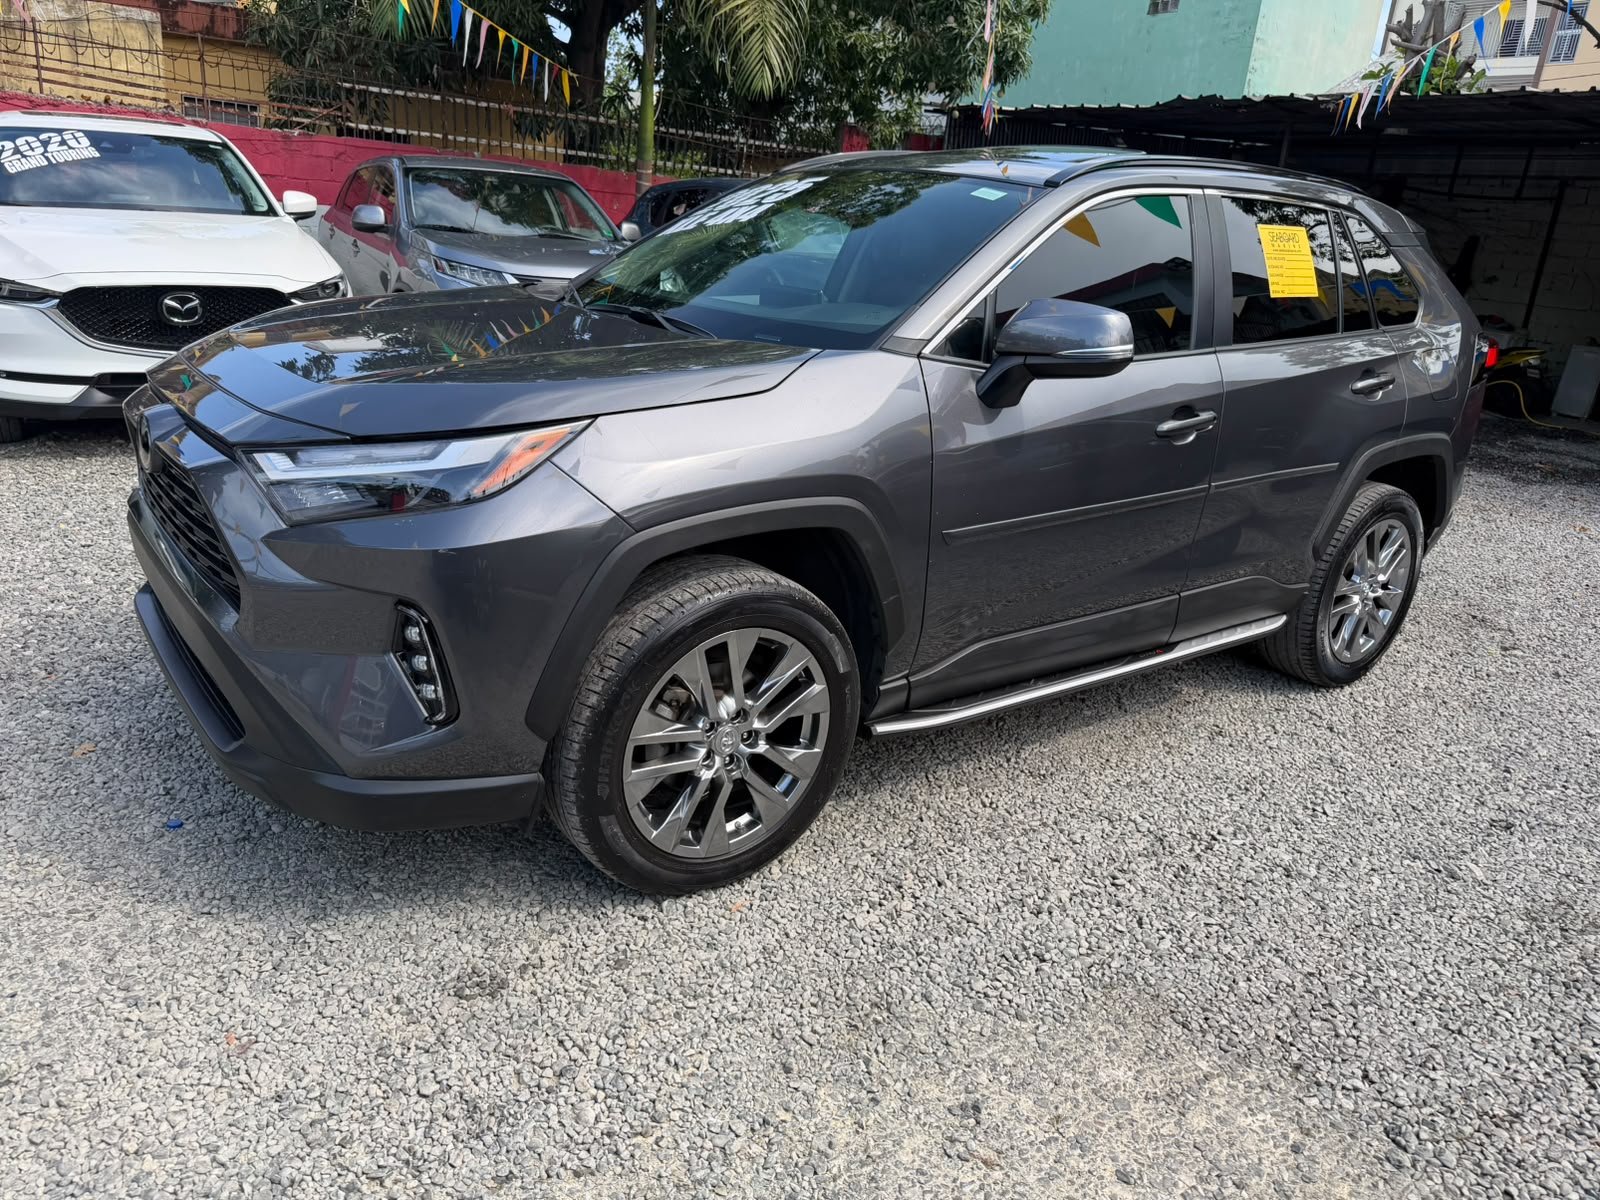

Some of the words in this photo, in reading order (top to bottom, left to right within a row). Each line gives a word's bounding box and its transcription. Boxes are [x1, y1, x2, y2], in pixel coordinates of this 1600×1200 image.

[0, 130, 91, 163] 2020
[4, 154, 48, 173] GRAND
[44, 146, 100, 164] TOURING
[1268, 231, 1299, 243] SEABOARD
